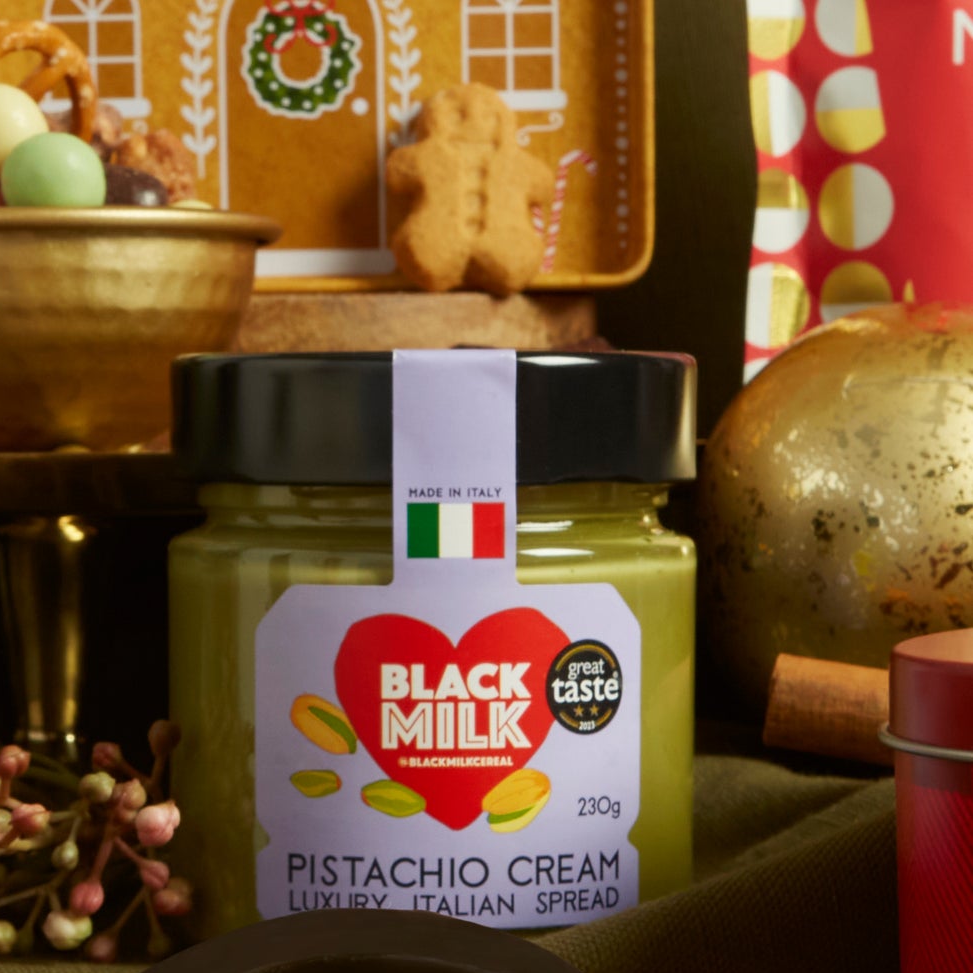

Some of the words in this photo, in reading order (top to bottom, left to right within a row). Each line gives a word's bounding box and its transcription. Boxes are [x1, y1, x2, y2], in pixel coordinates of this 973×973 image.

[409, 487, 443, 497] MADE
[449, 487, 461, 497] IN
[467, 487, 502, 497] ITALY
[381, 663, 531, 700] BLACK
[568, 658, 605, 680] great
[381, 701, 532, 750] MILK
[578, 796, 621, 819] 230g
[287, 852, 489, 888] PISTACHIO
[508, 850, 620, 886] CREAM
[289, 890, 388, 911] LUXURY
[413, 893, 515, 916] ITALIAN
[535, 887, 620, 915] SPREAD
